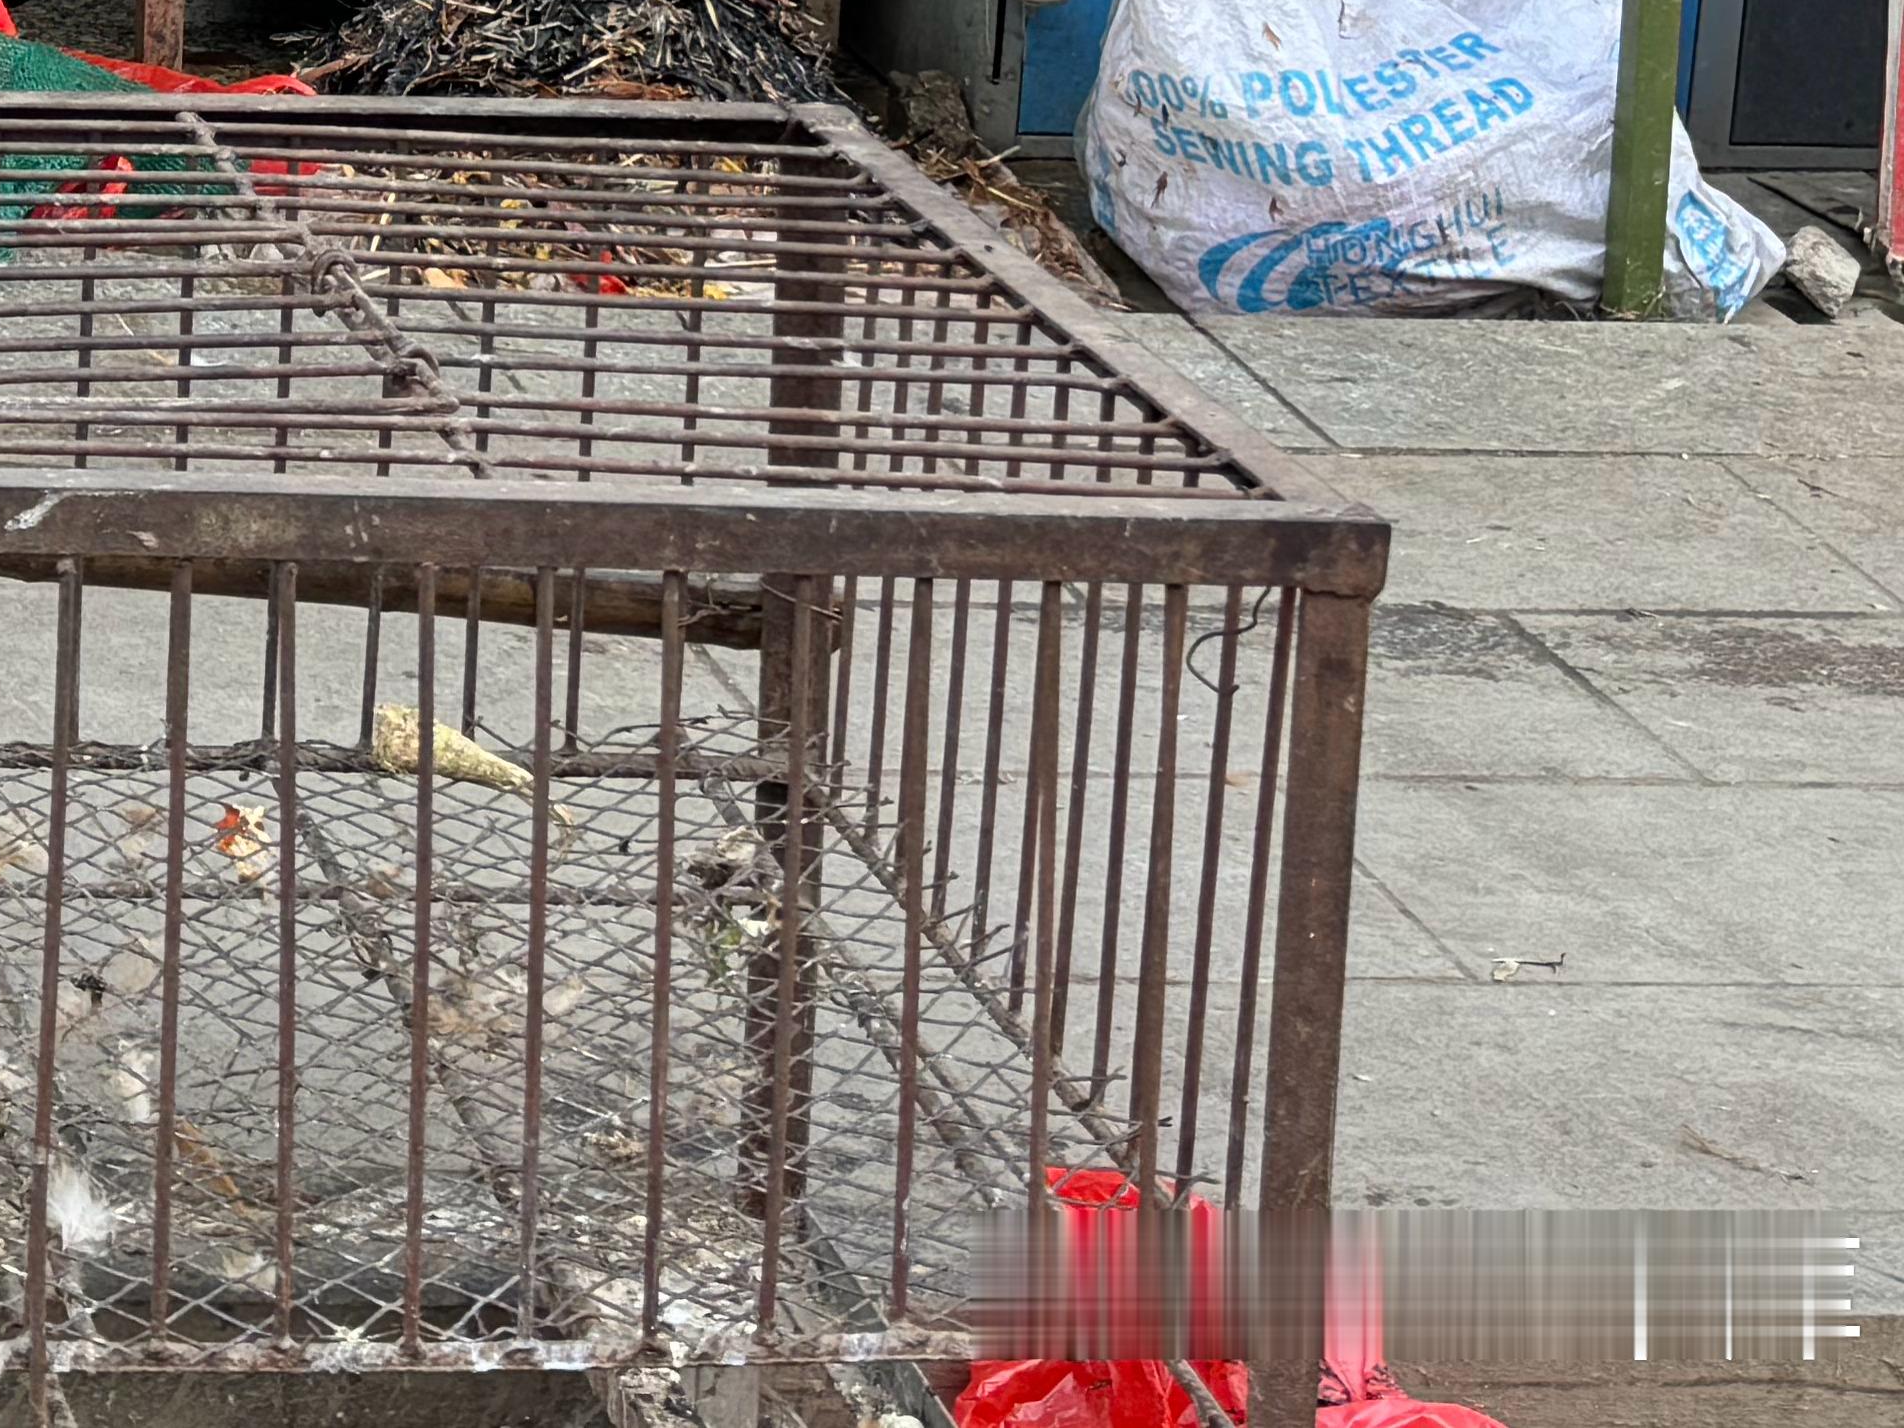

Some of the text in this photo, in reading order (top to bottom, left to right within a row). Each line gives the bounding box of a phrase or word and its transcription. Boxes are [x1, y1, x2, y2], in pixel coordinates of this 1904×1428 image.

[1241, 29, 1503, 119] POLESTER
[1149, 75, 1536, 187] SEWING THREAD
